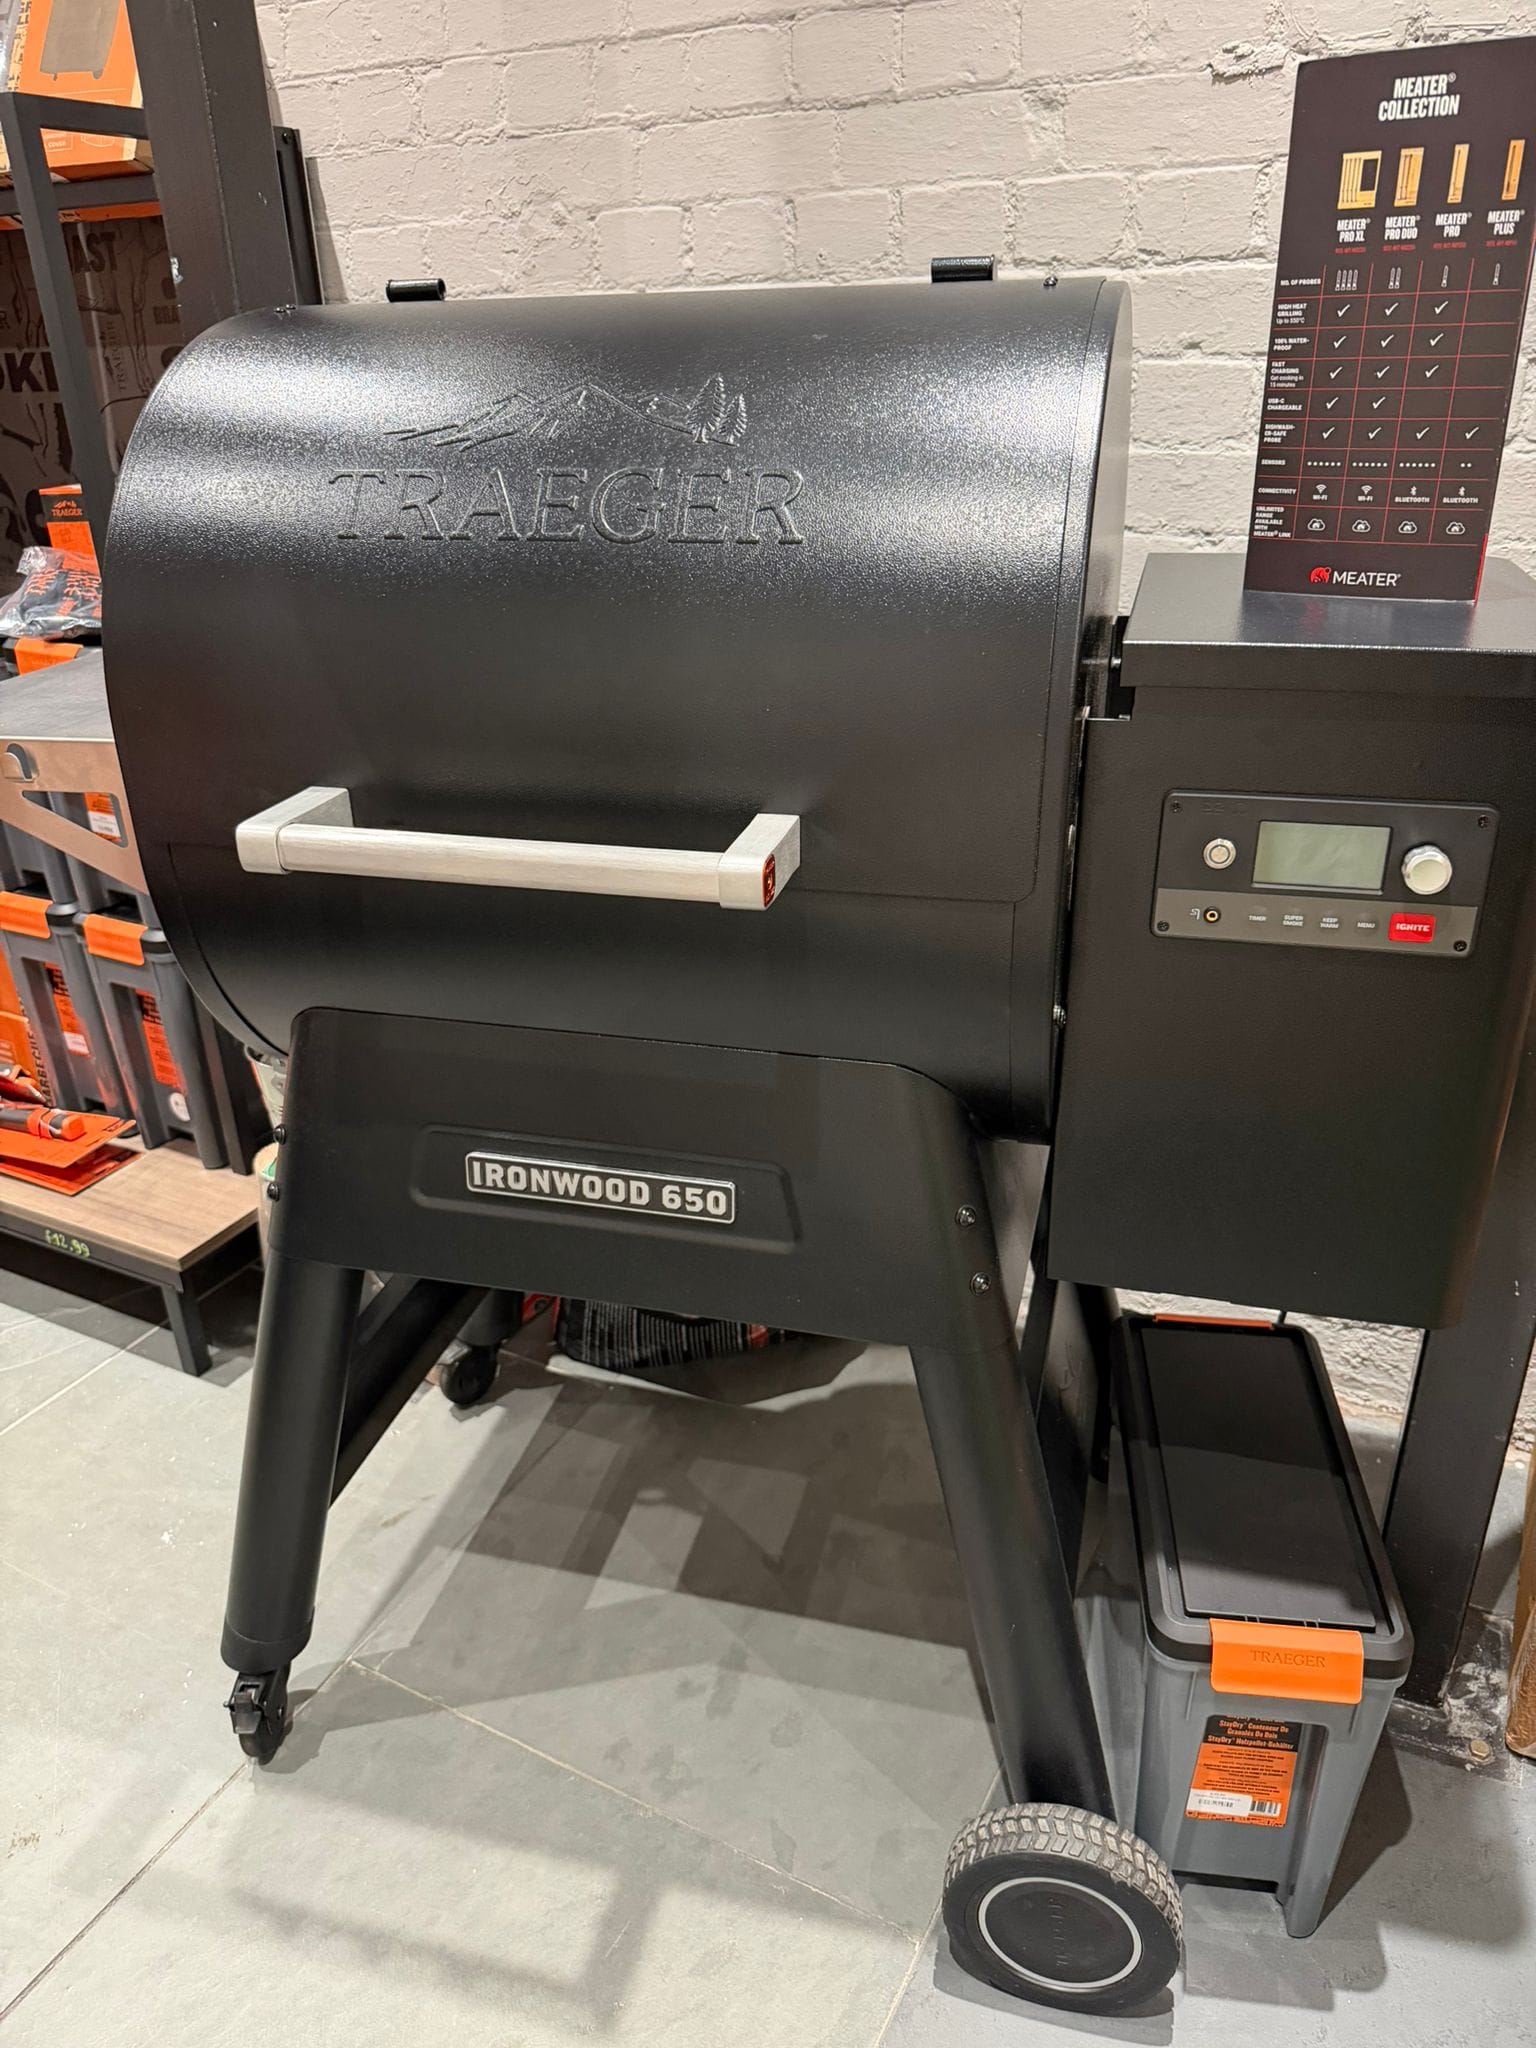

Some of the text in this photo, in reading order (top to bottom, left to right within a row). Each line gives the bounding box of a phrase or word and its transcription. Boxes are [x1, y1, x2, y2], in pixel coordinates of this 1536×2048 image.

[1378, 94, 1460, 121] COLLECTION
[1339, 230, 1365, 243] PRO XL
[1384, 227, 1418, 240] PRO DUO
[1443, 225, 1460, 238] PRO
[1493, 223, 1515, 235] PLUS
[72, 231, 118, 273] AST
[52, 509, 83, 517] TRAEGER
[329, 468, 804, 544] TRAEGER
[1395, 923, 1430, 932] IGNITE
[28, 1032, 52, 1102] ARBECUE
[472, 1161, 727, 1216] IRONWOOD 650
[1250, 1650, 1326, 1668] TRAEGER
